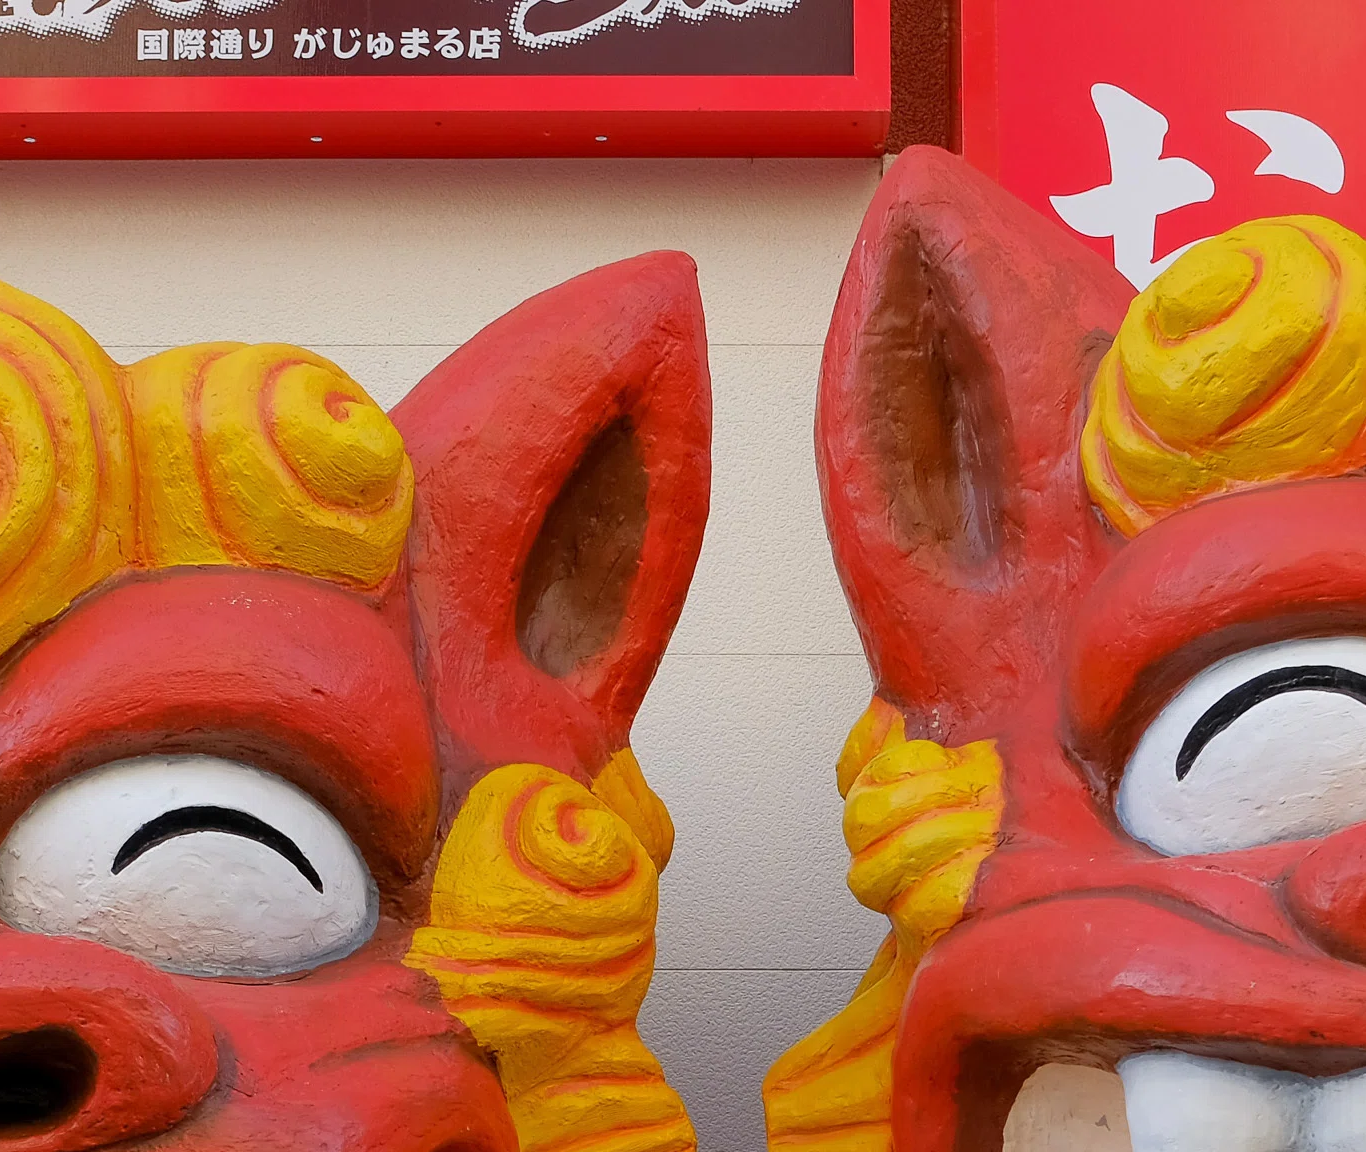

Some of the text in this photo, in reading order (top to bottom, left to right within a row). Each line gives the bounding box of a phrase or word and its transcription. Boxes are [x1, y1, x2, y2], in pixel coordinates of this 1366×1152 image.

[136, 27, 502, 61] 国際通り がじゅまる店
